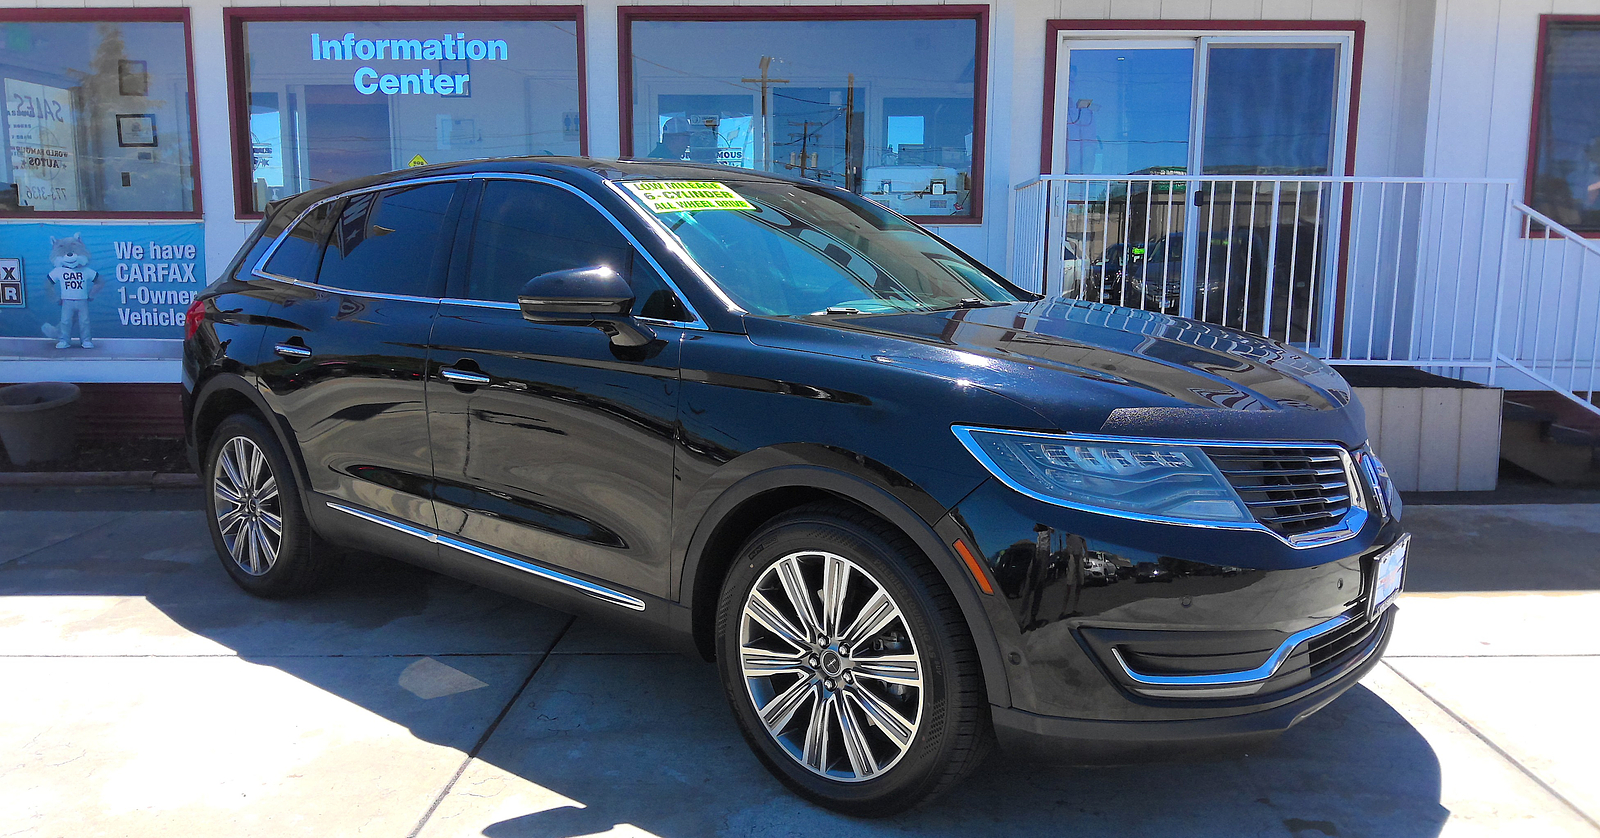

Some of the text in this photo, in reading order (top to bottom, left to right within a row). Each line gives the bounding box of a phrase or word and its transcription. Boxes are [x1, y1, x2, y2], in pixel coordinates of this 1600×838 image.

[310, 32, 508, 61] Information
[353, 66, 470, 95] Center
[717, 151, 742, 159] MOUS
[633, 182, 722, 191] LOW MILEAGE
[655, 200, 749, 211] ALL WHEEL DRIVE
[114, 241, 196, 260] We have
[63, 272, 83, 281] CAR
[115, 263, 197, 283] CARFAX
[65, 281, 83, 290] FOX
[117, 286, 199, 305] 1-Owner
[117, 308, 187, 327] Vehicle
